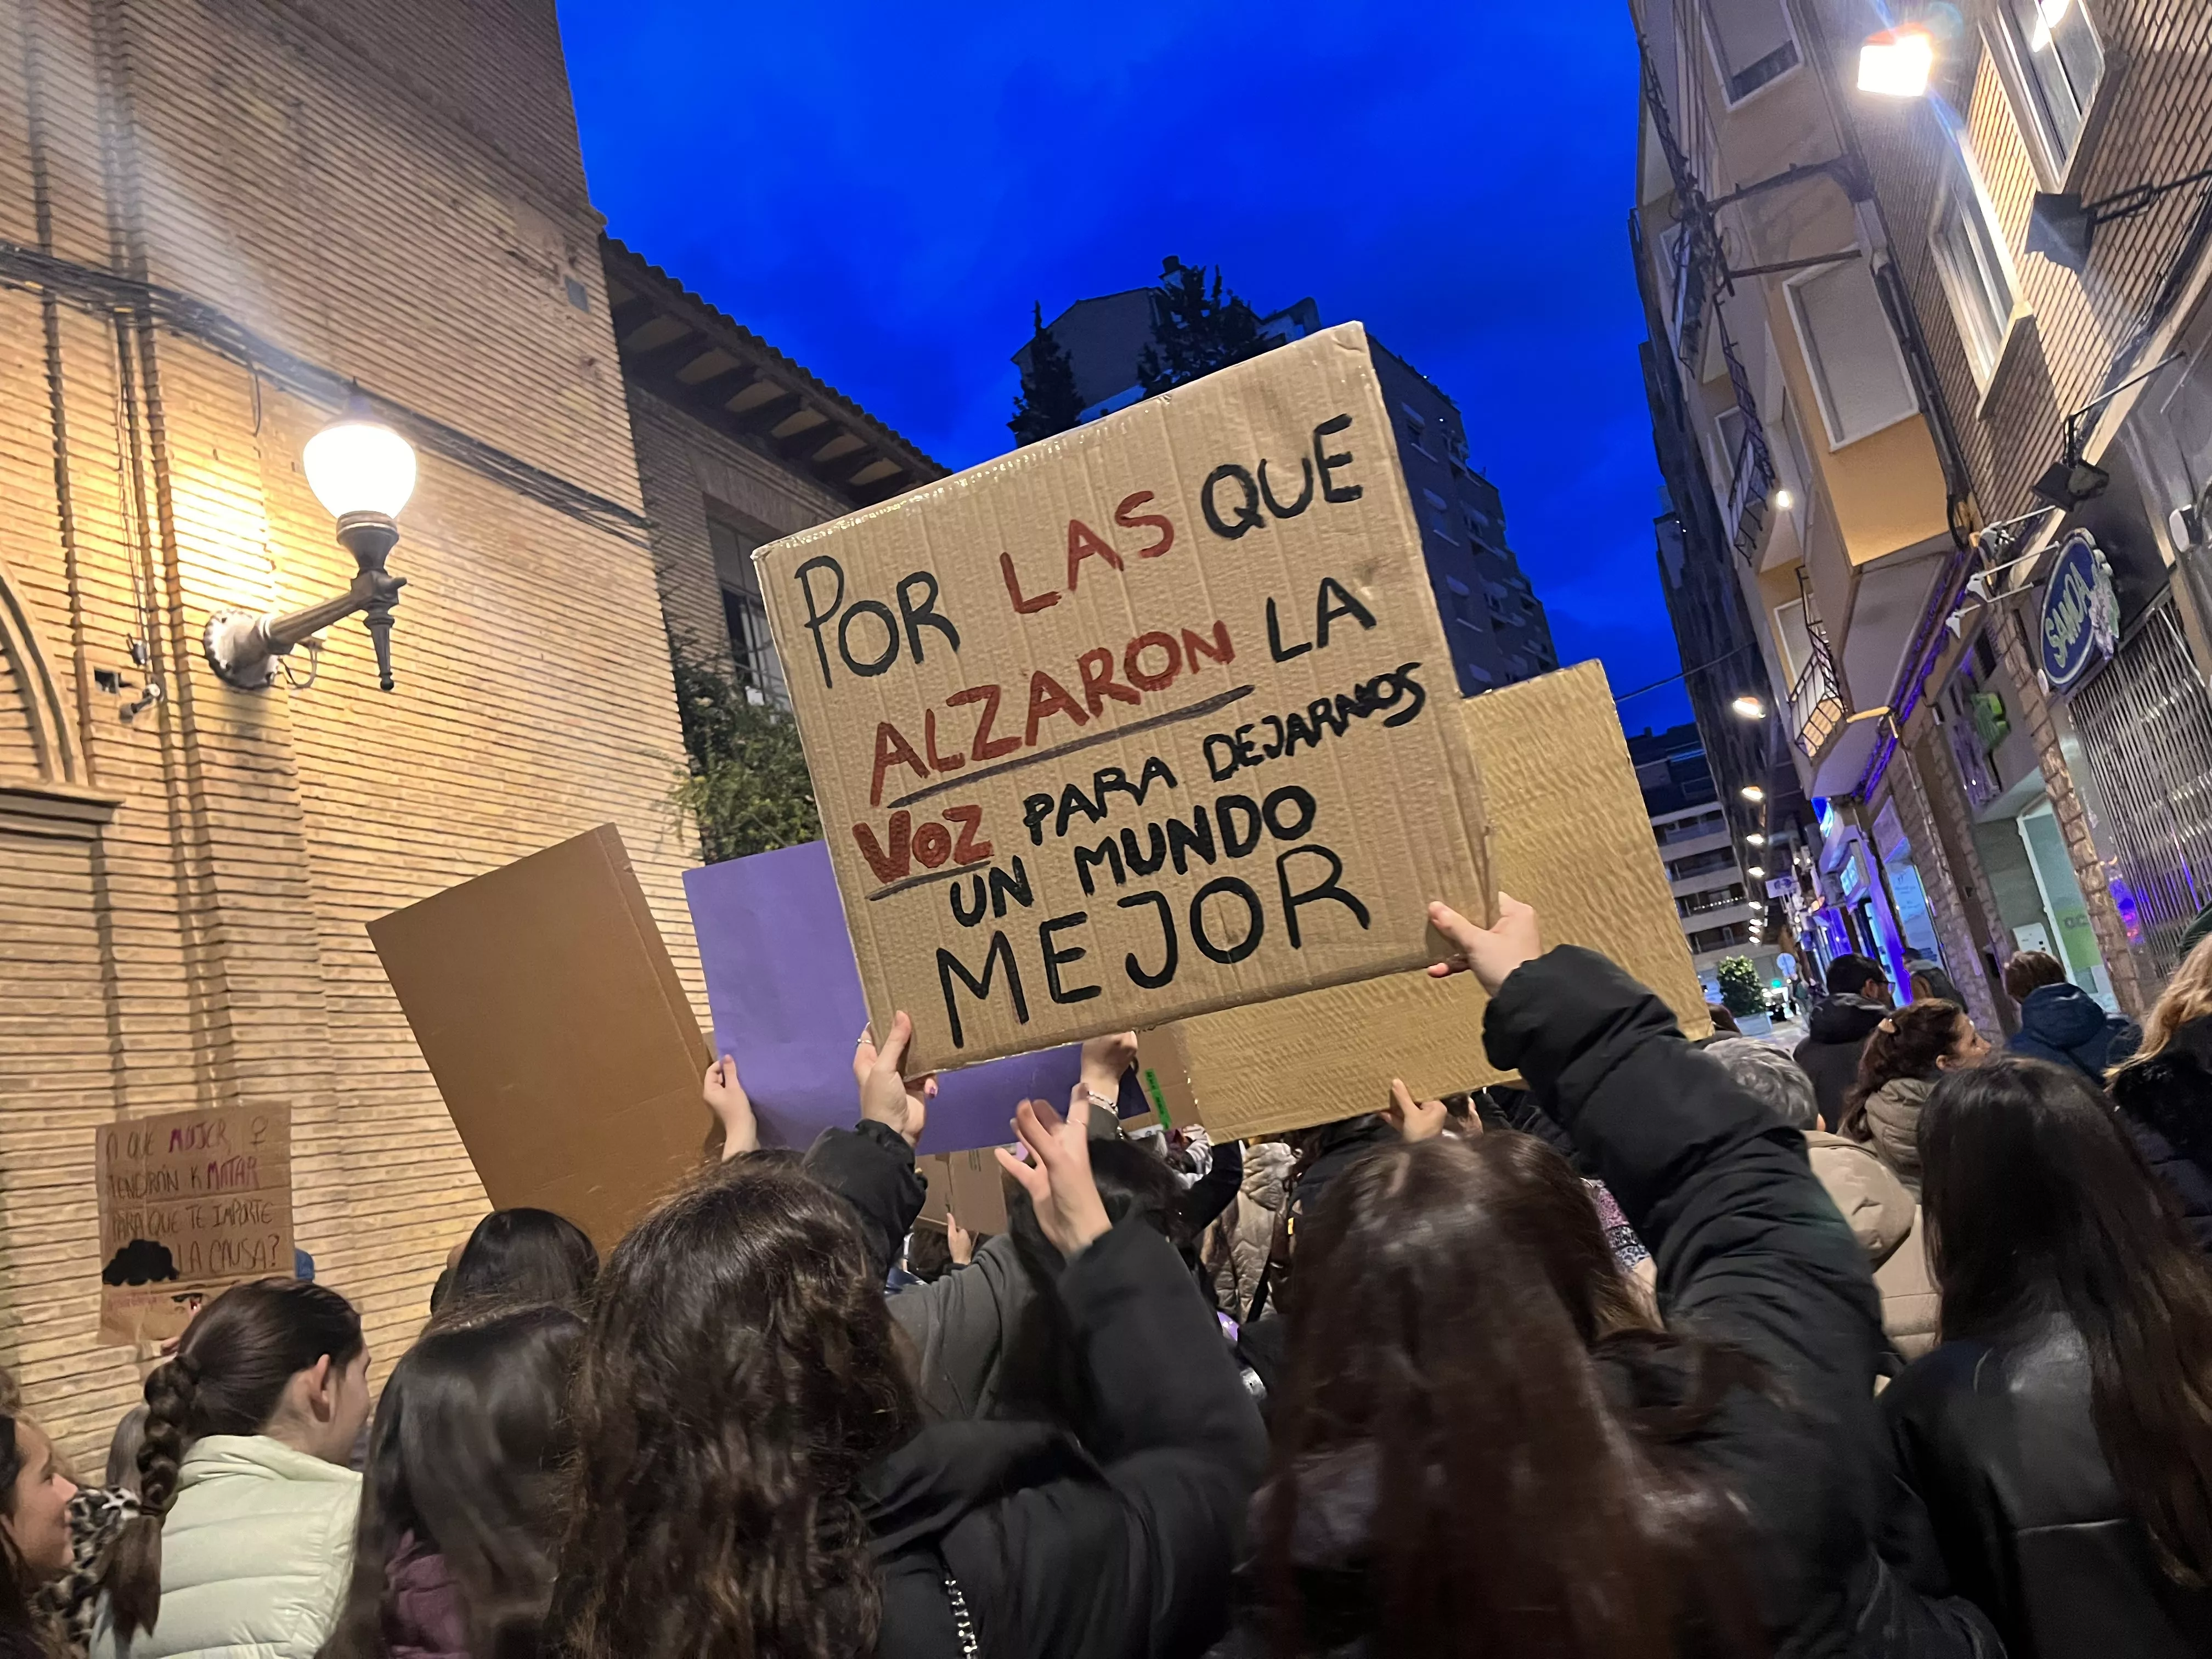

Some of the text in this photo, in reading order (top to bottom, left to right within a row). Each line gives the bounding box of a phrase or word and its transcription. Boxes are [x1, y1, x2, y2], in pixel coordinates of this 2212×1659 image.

[794, 413, 1363, 689] POR LAS QUE
[851, 662, 1426, 884] VOZ PARA DEJARNOS
[869, 577, 1377, 807] ALZARON LA
[949, 785, 1317, 928] UN MUNDO
[935, 844, 1370, 1049] MEJOR
[148, 1209, 182, 1238] QUE
[185, 1204, 206, 1229] TE
[211, 1198, 275, 1228] IMPORTE
[191, 1164, 202, 1190] K
[207, 1155, 261, 1190] MATAR
[209, 1233, 280, 1274] CAUSA?
